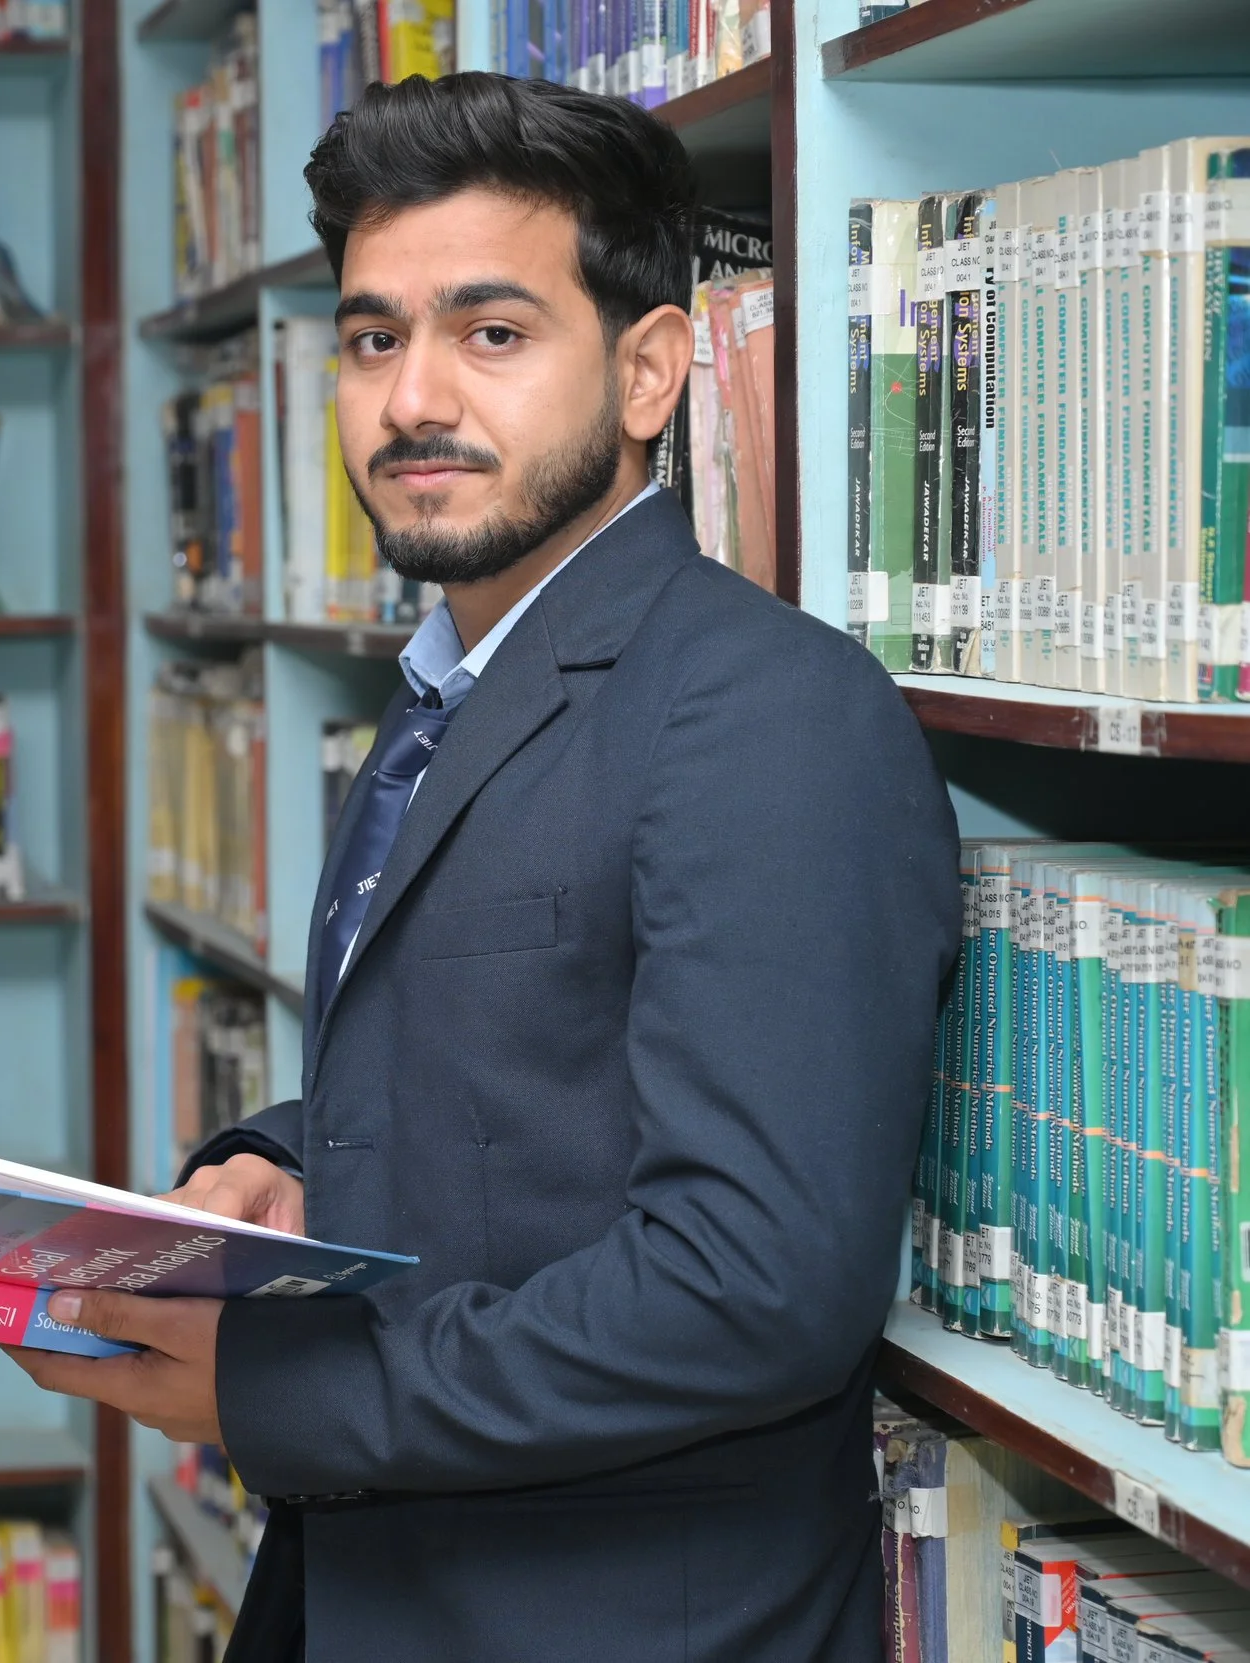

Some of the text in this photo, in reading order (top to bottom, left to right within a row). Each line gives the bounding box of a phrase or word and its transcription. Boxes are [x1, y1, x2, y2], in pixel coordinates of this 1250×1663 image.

[850, 328, 860, 394] Systems
[919, 330, 930, 397] Systems
[957, 323, 971, 392] Systems
[850, 427, 866, 438] Second
[851, 439, 865, 449] Edition
[919, 430, 936, 440] Second
[919, 441, 936, 452] Edition
[957, 425, 976, 436] Second
[957, 437, 975, 448] Edition
[962, 476, 971, 560] JAWADEKAR
[414, 731, 438, 750] JIET
[985, 952, 998, 1151] Oriented Numerical Methods
[952, 1089, 962, 1148] Methods
[970, 1098, 979, 1157] Methods
[1, 1249, 71, 1279] Social
[48, 1247, 139, 1287] Network
[147, 1235, 227, 1275] Analytics
